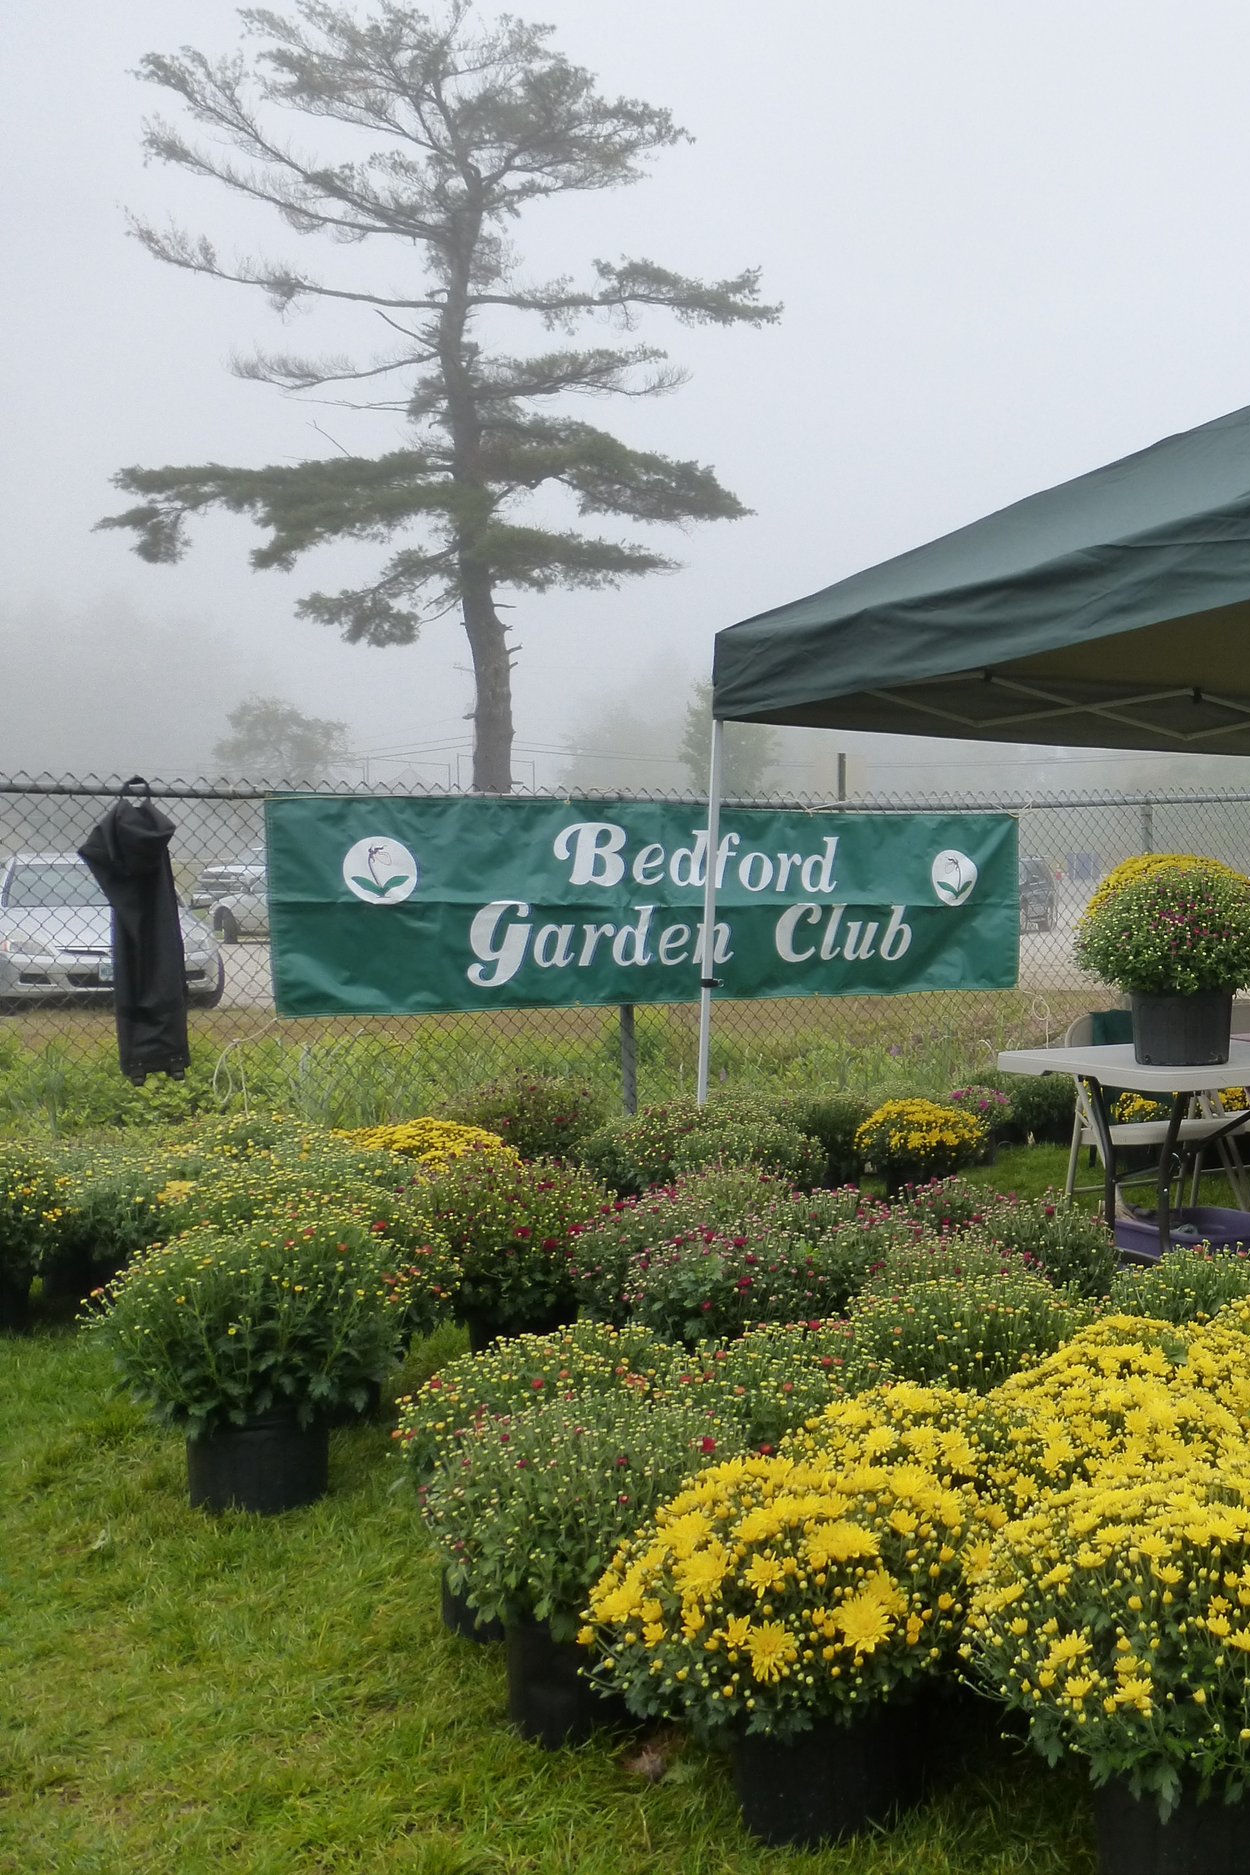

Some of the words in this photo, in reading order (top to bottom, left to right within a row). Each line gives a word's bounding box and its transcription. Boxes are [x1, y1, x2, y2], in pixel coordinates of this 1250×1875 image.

[553, 822, 840, 893] Bedford
[467, 900, 734, 987] Garden
[775, 902, 912, 963] Club
